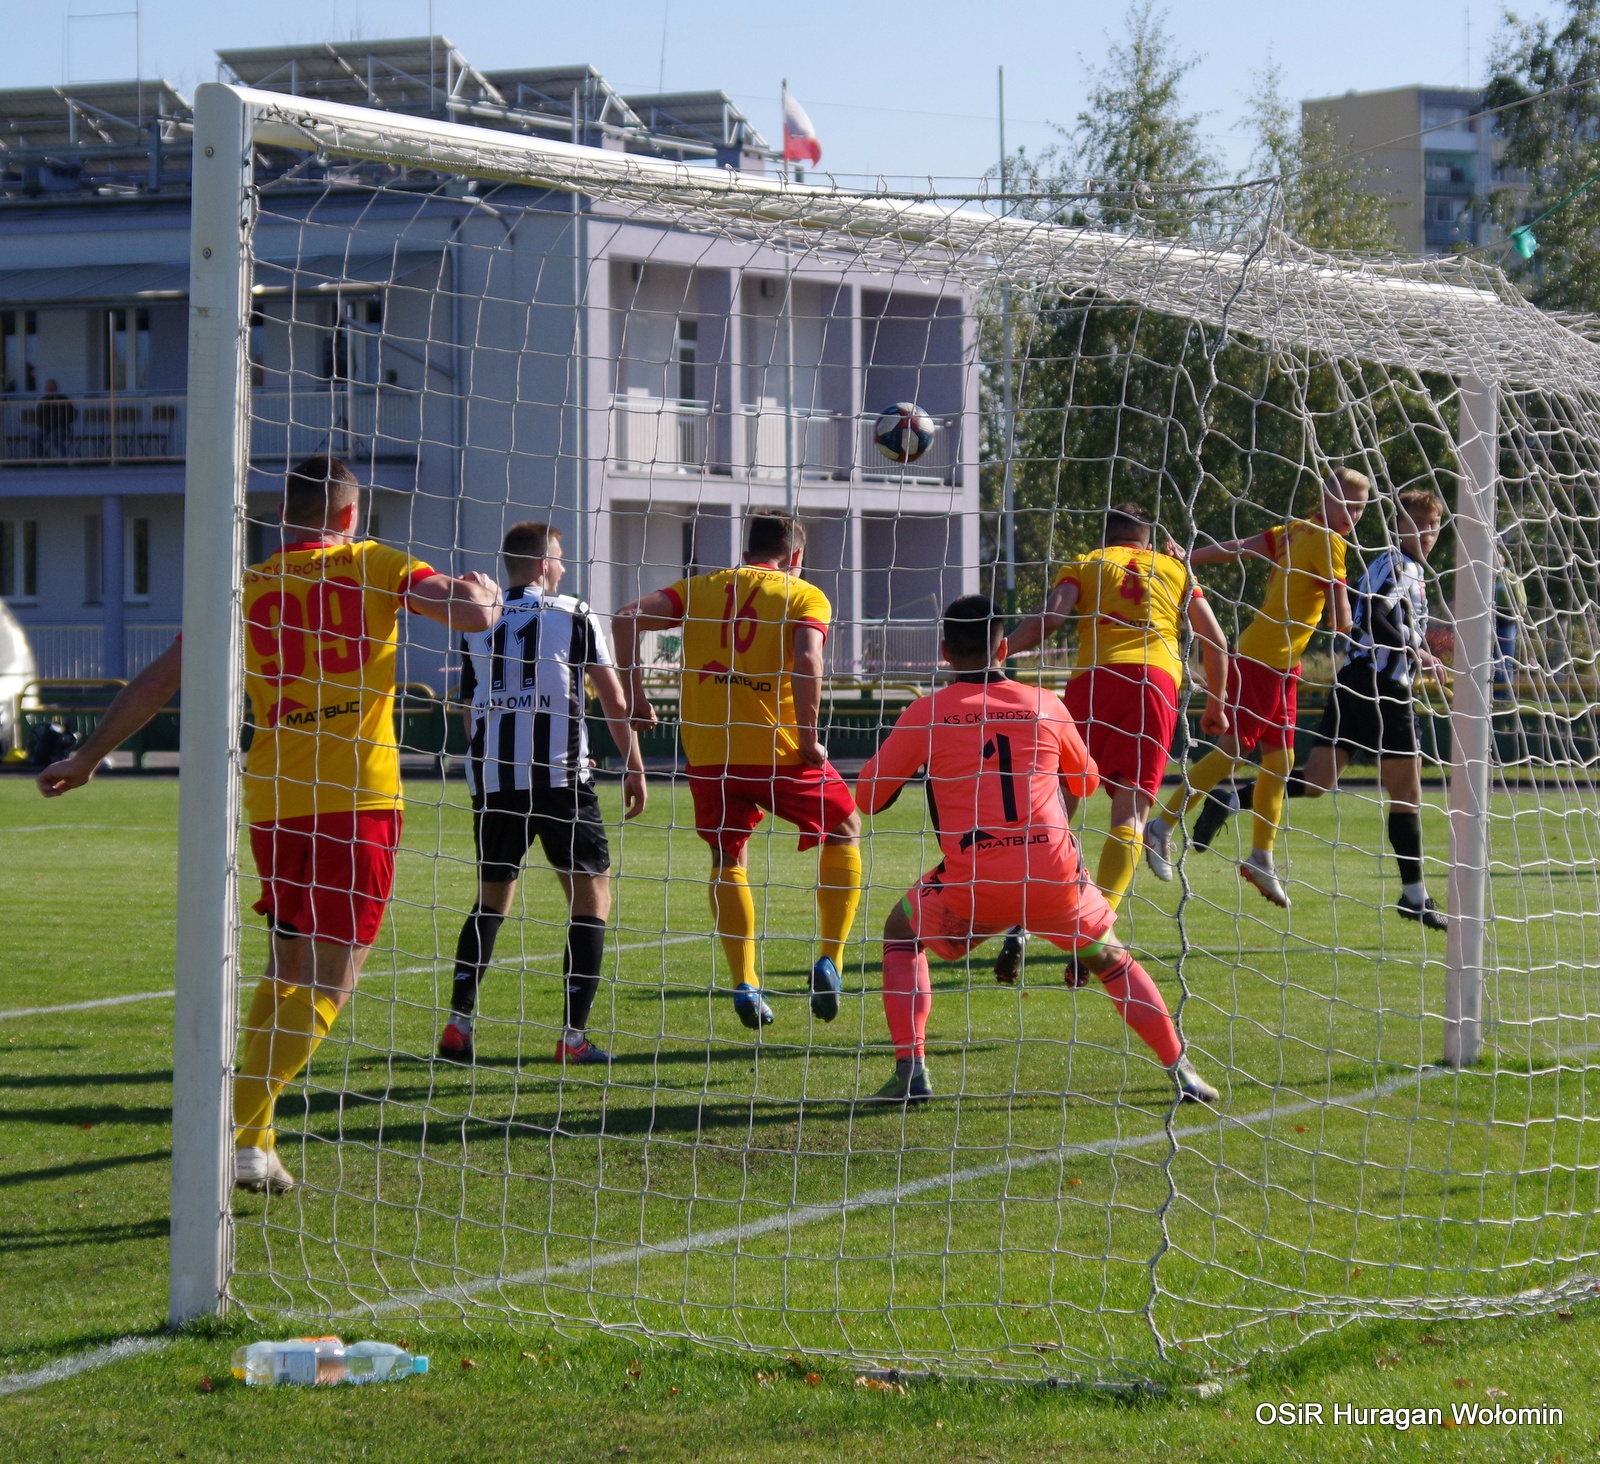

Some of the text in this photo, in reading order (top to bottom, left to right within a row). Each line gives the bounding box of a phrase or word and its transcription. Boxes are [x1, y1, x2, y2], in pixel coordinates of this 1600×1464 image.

[286, 555, 353, 575] TROSZYN
[1120, 558, 1145, 606] 4
[248, 575, 371, 688] 99
[721, 583, 761, 654] 16
[484, 614, 540, 693] 11
[944, 715, 960, 724] KS
[965, 713, 982, 722] CK
[979, 733, 1018, 822] 1
[977, 834, 1050, 850] MATBUD
